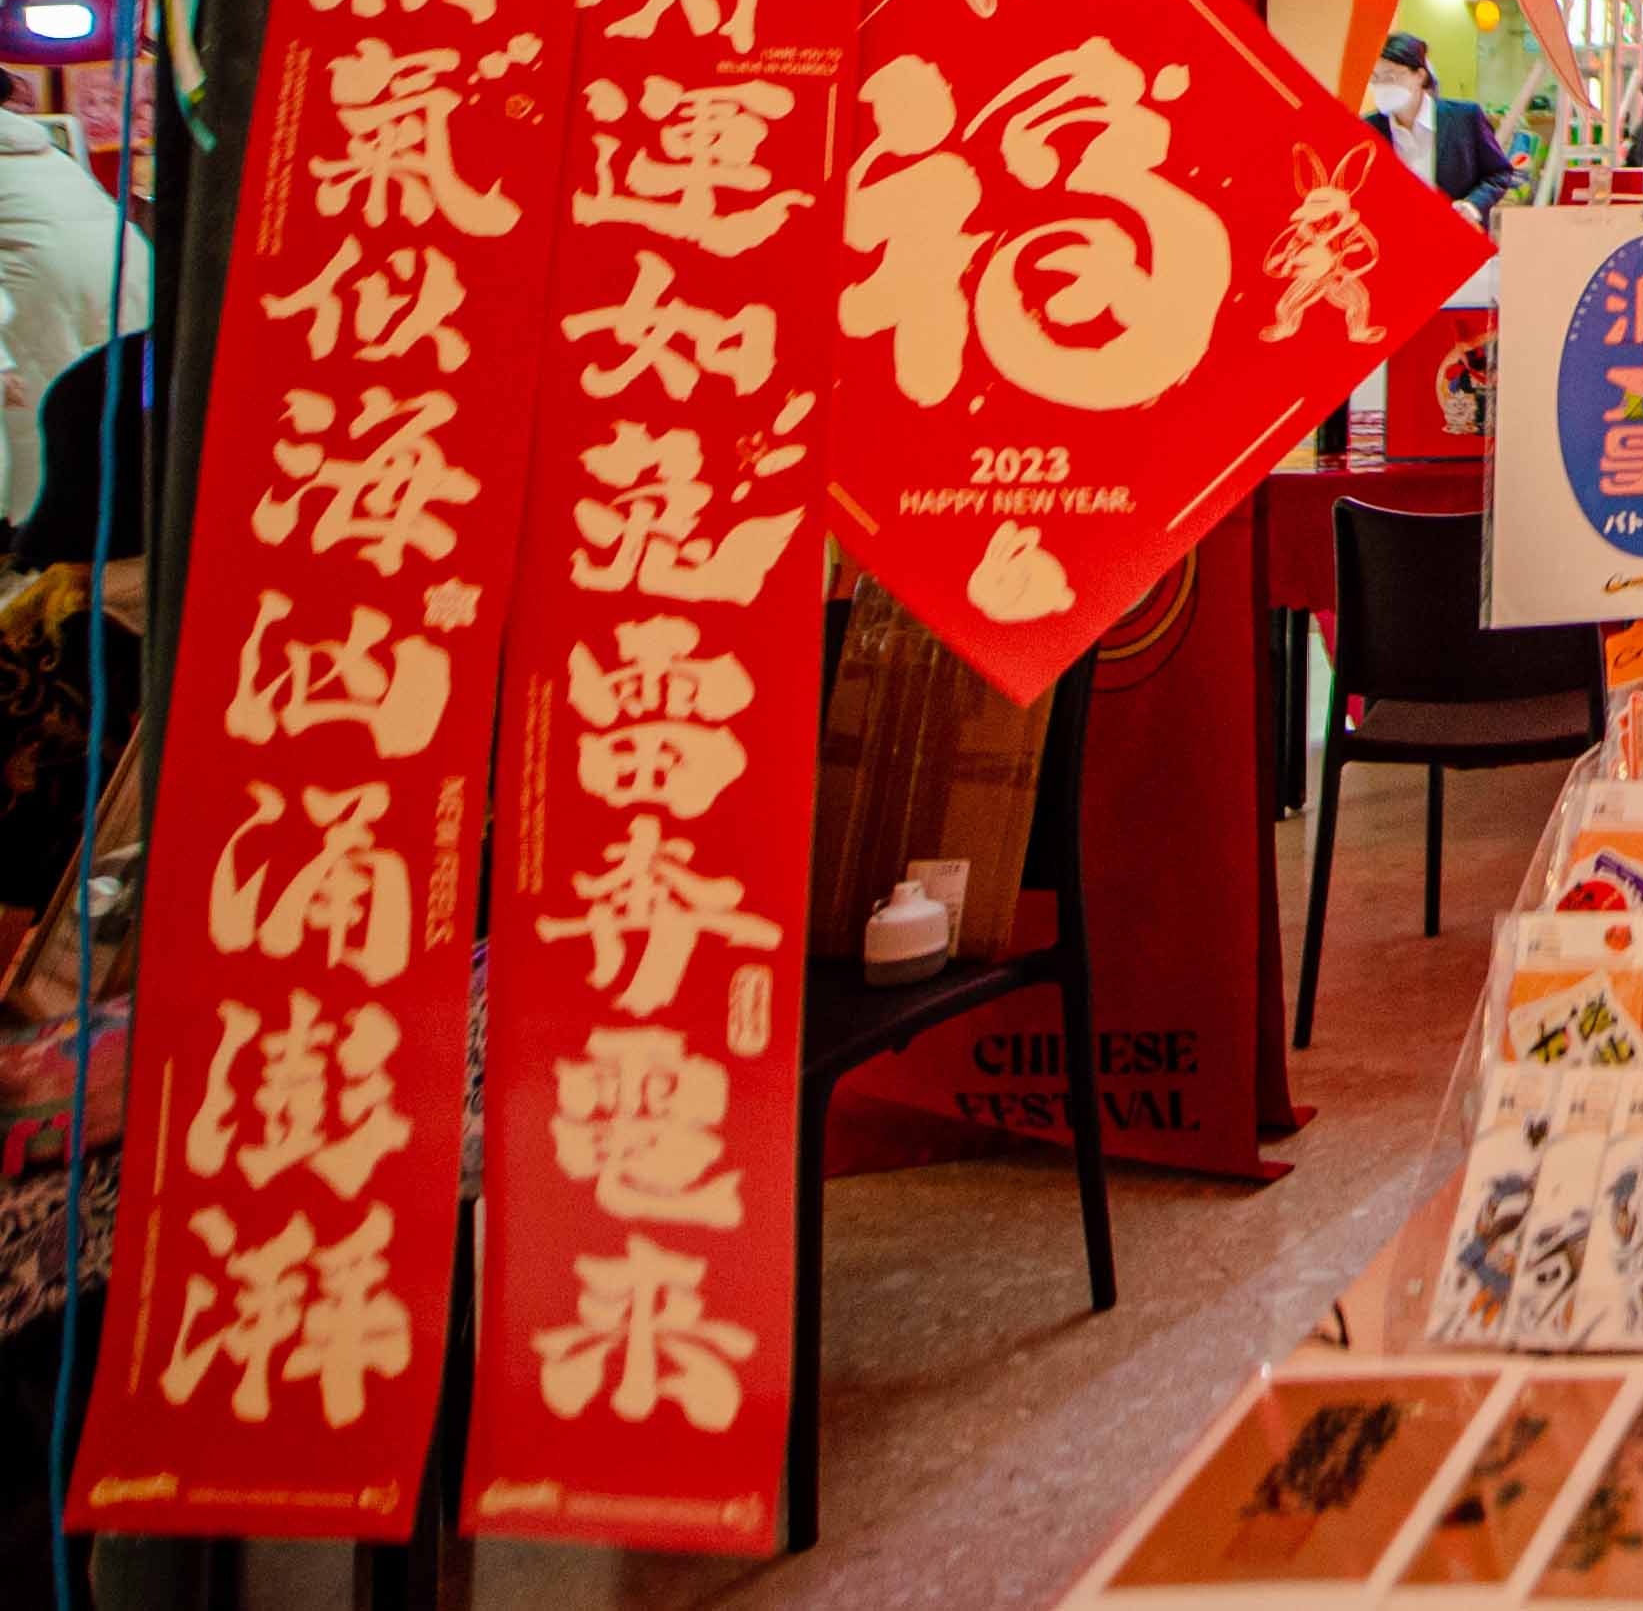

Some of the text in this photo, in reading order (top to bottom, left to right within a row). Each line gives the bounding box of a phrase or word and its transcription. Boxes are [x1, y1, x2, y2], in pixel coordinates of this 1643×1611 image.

[838, 37, 1232, 411] 福
[970, 446, 1070, 484] 2023
[900, 489, 986, 515] HAPPY
[991, 488, 1056, 515] NEW
[973, 1030, 1198, 1077] CHIESE
